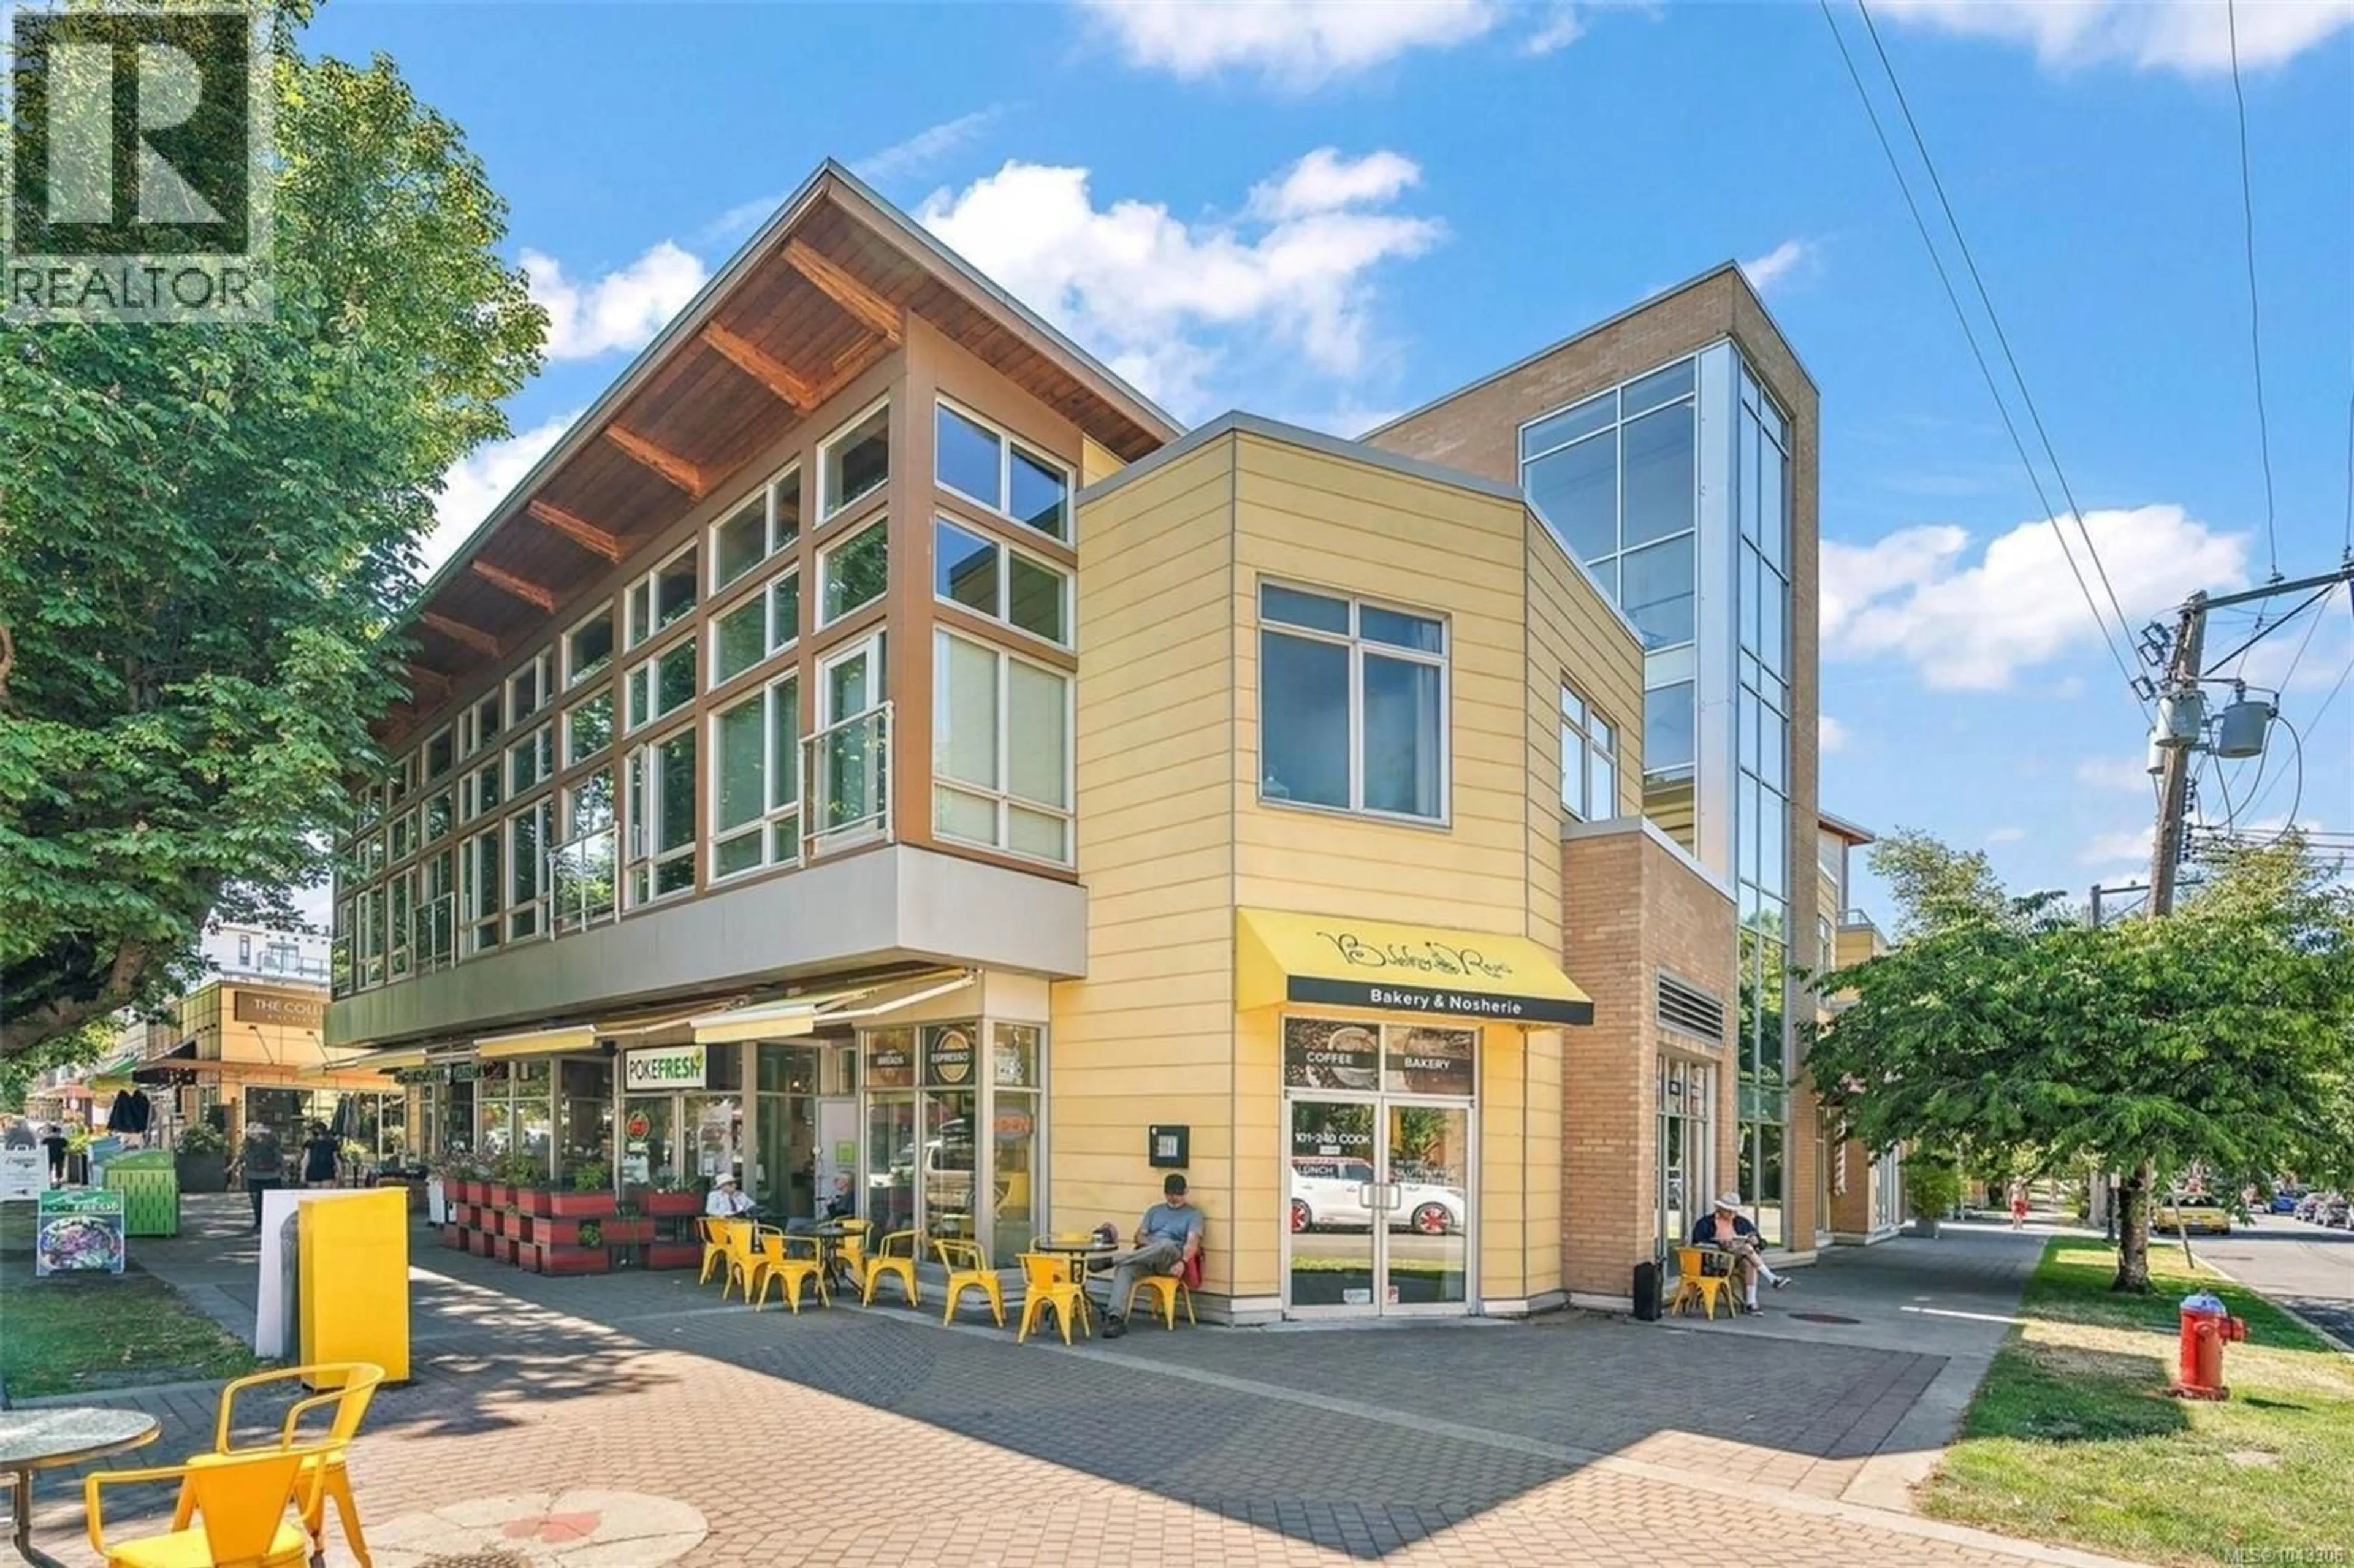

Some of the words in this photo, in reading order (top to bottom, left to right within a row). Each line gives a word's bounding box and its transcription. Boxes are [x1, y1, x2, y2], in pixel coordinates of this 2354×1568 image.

[254, 999, 280, 1011] THE
[1371, 988, 1430, 1009] Bakery
[1433, 994, 1445, 1008] &
[1450, 997, 1522, 1014] Nosherie
[931, 1051, 969, 1063] ESPRESSO
[1306, 1051, 1353, 1064] COFFEE
[630, 1056, 701, 1081] POKEFRESH
[1404, 1057, 1451, 1070] BAKERY
[1339, 1133, 1371, 1145] COOK
[1298, 1166, 1333, 1175] LUNCH
